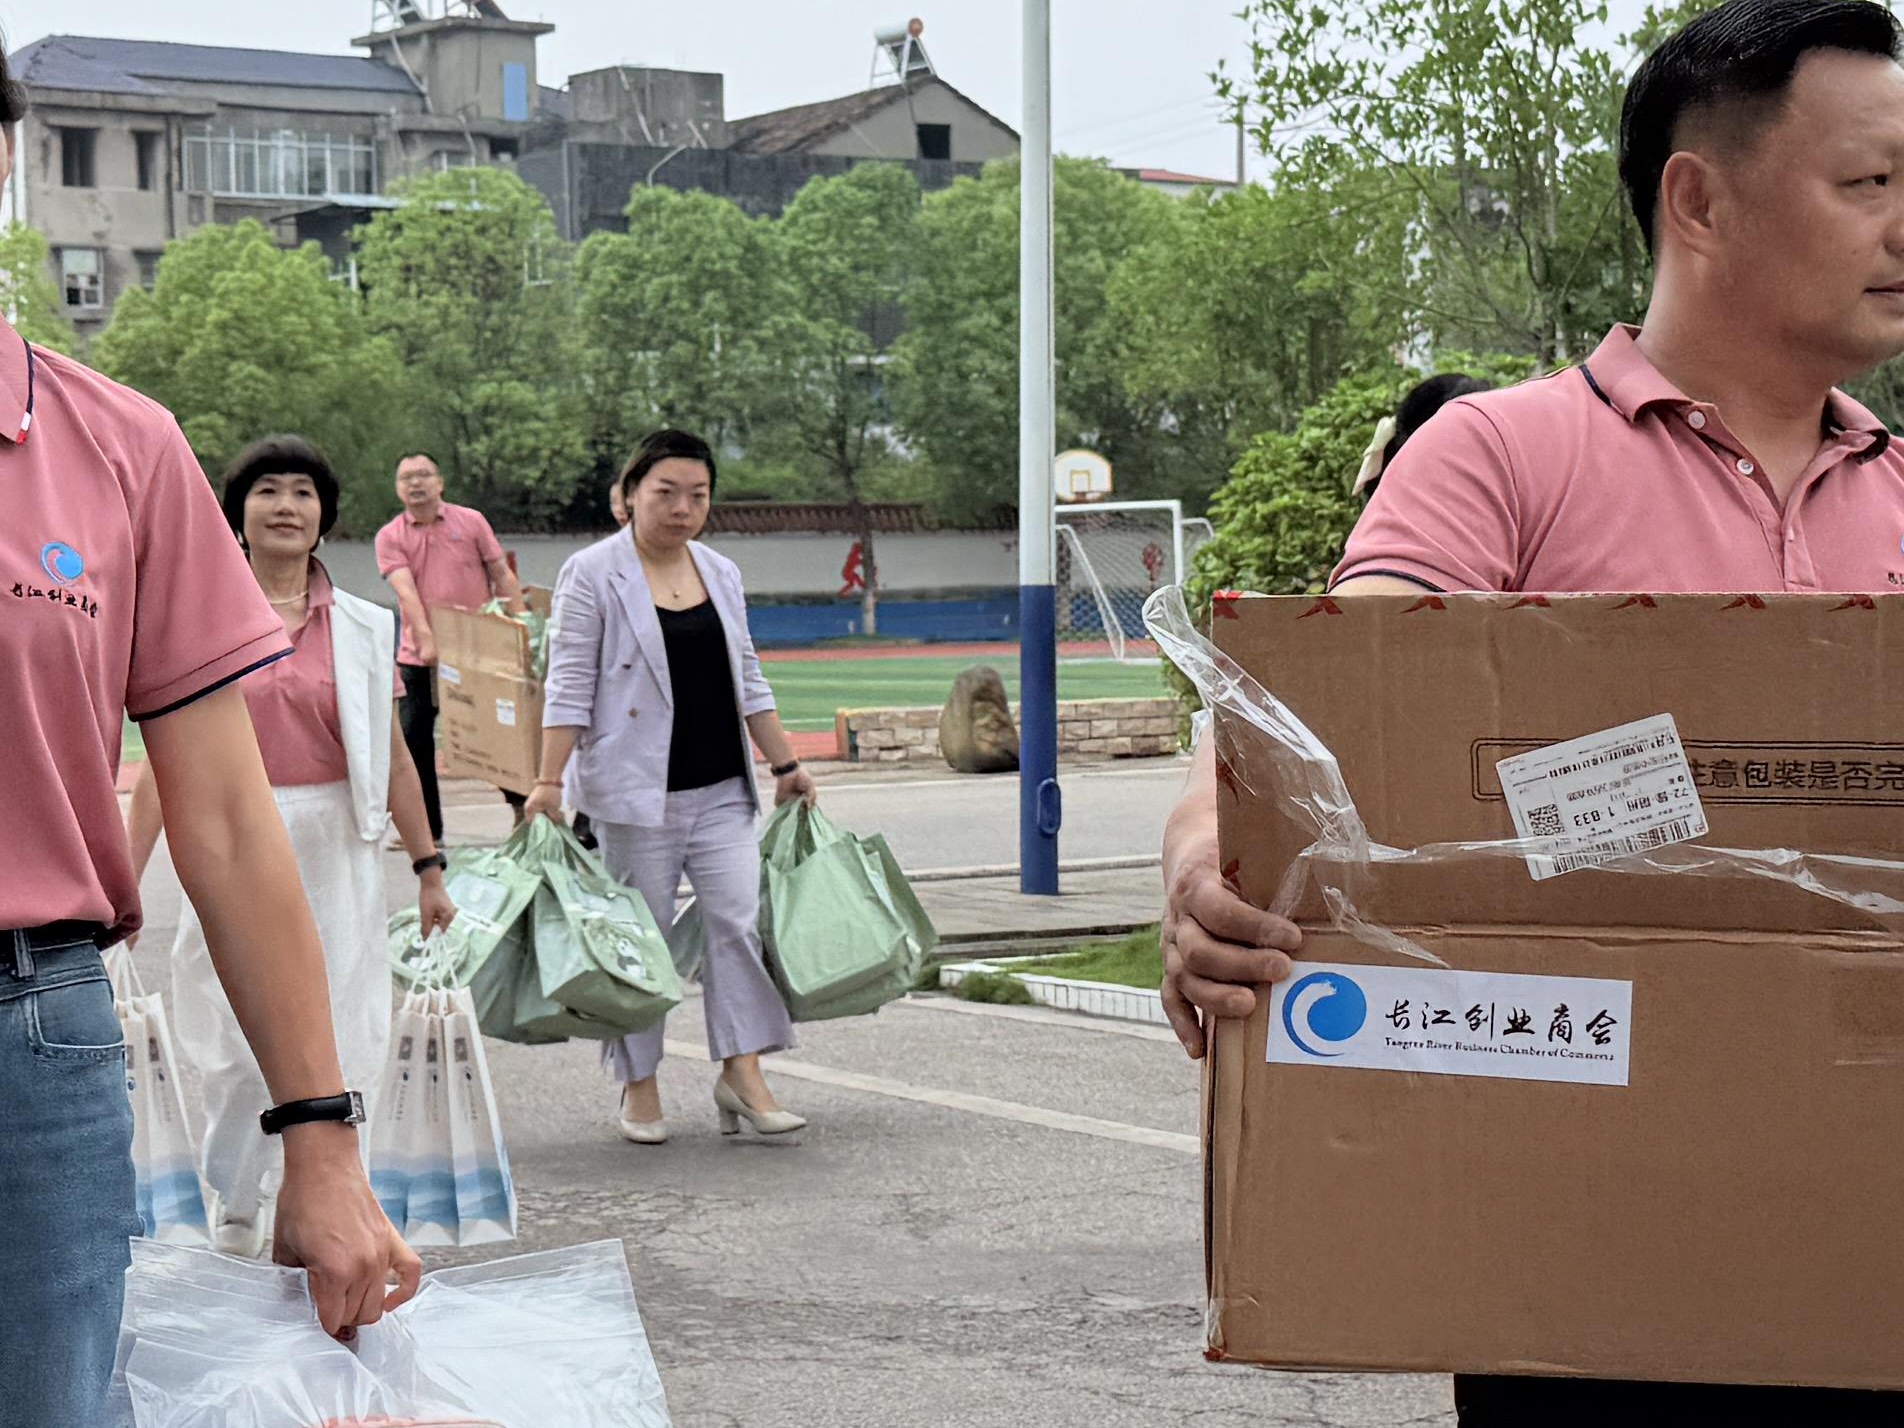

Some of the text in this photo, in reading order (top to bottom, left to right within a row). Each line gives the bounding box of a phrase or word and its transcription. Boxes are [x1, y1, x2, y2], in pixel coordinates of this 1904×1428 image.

[1385, 999, 1619, 1046] 长江创业商会
[1500, 1044, 1545, 1057] Chamber
